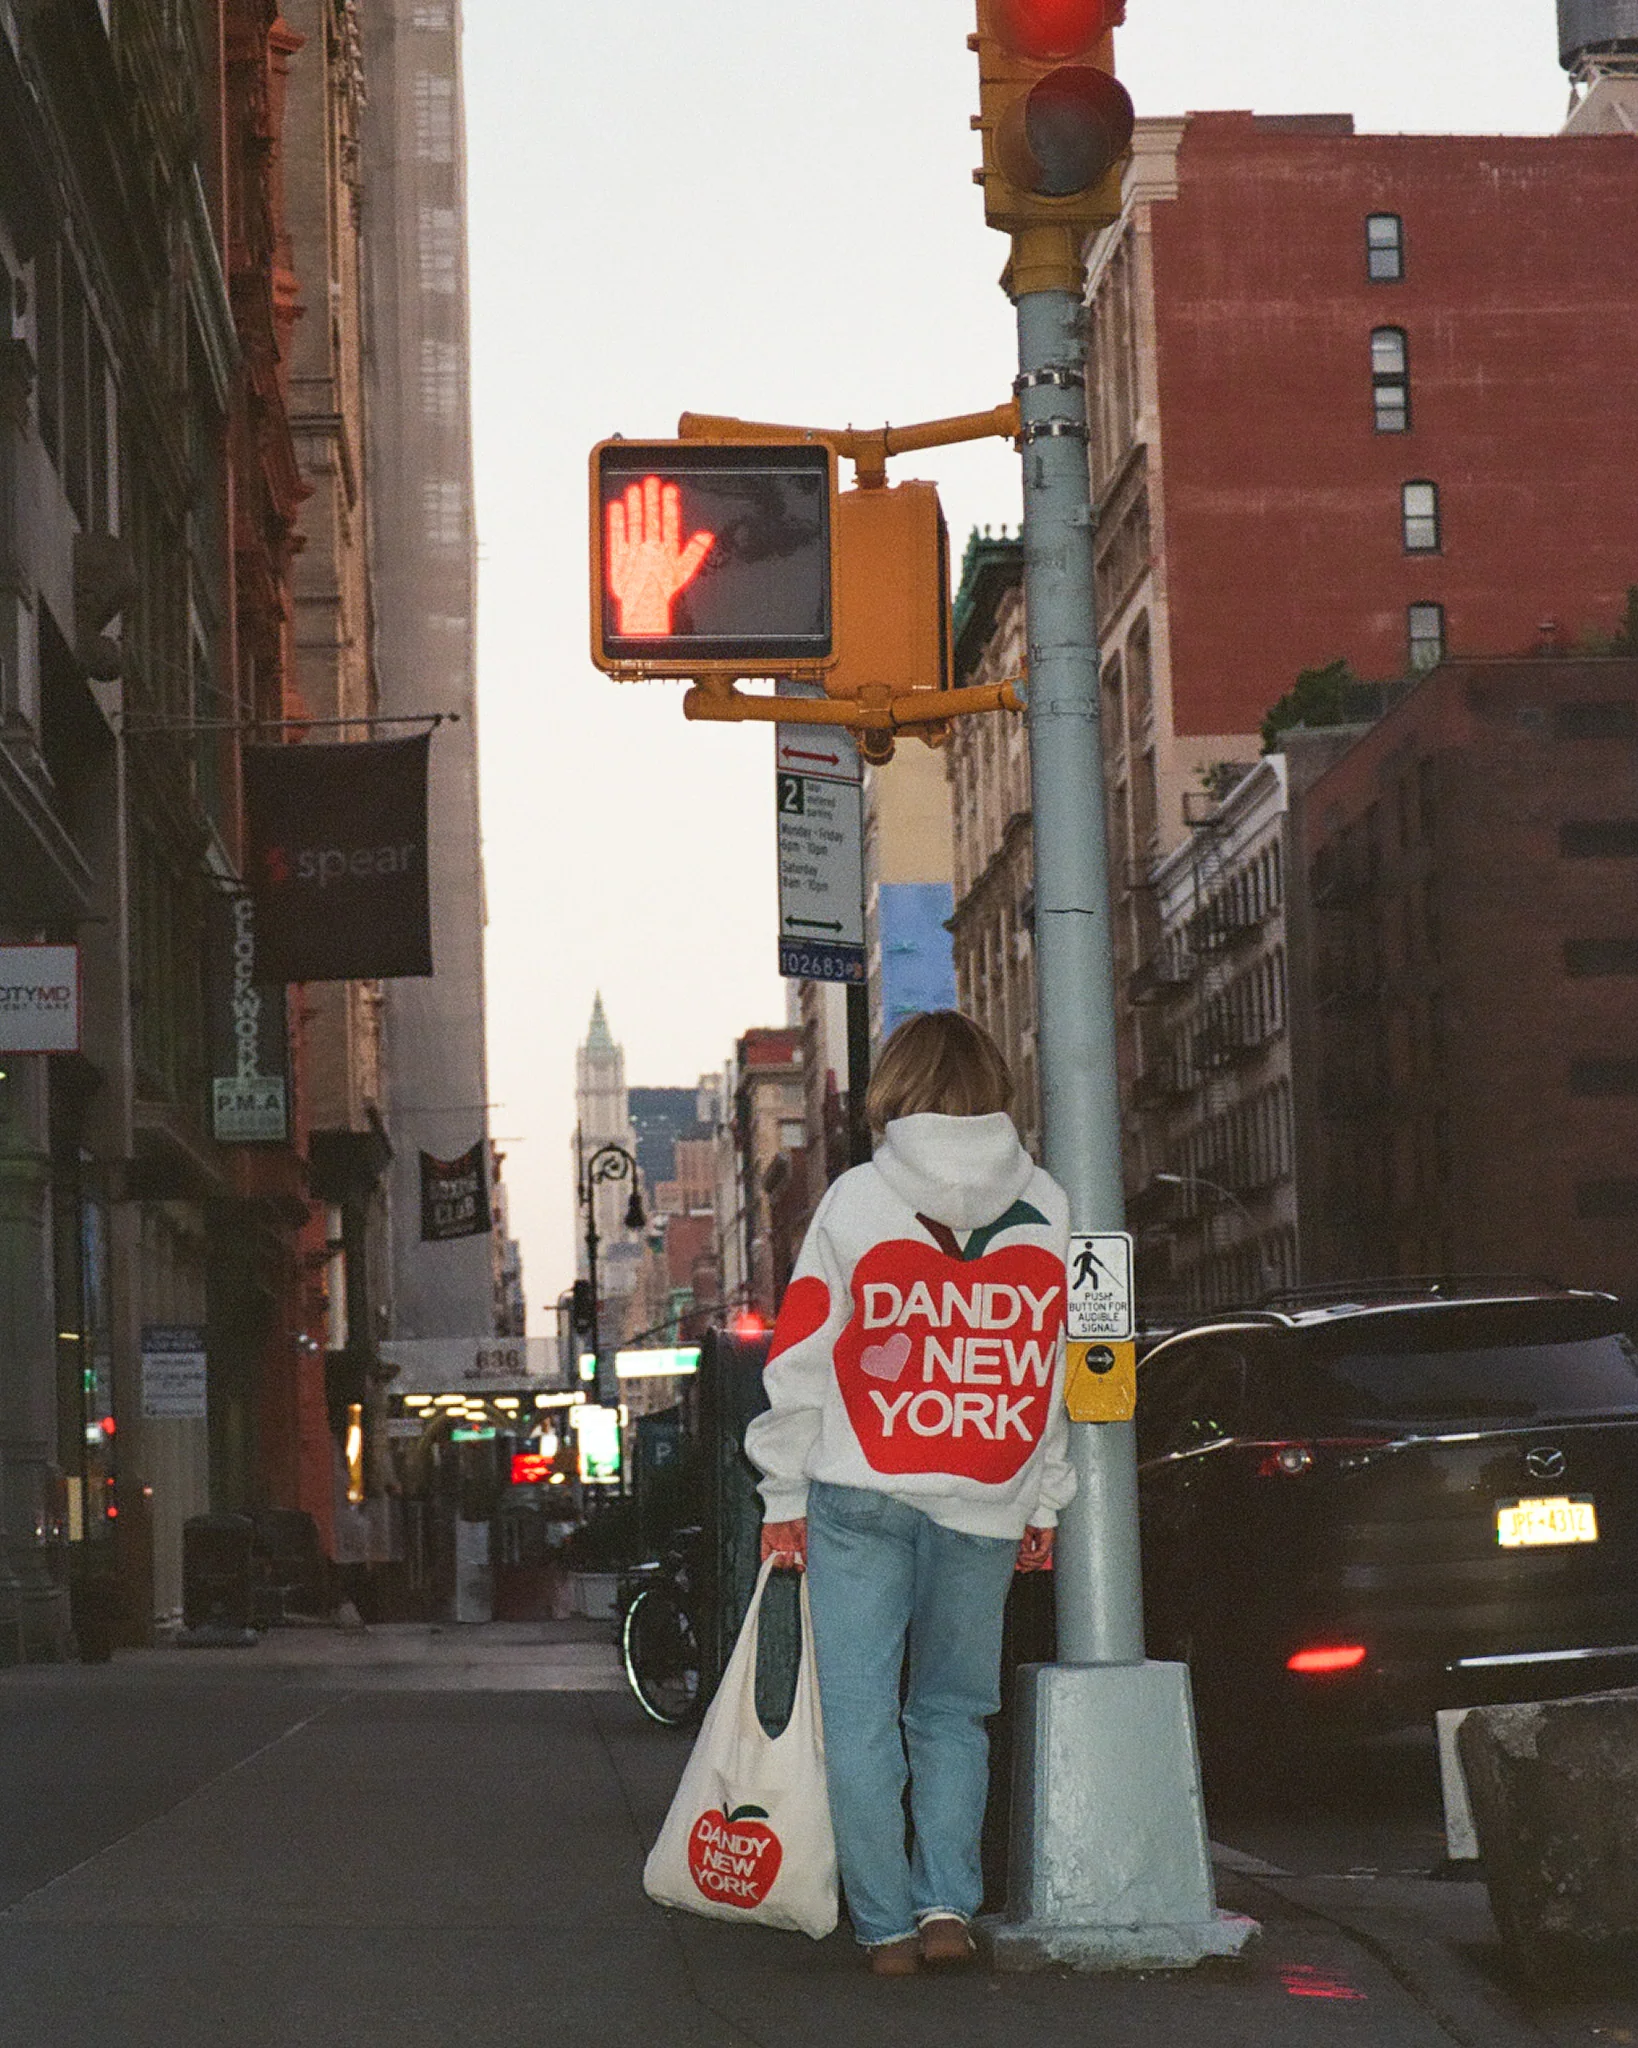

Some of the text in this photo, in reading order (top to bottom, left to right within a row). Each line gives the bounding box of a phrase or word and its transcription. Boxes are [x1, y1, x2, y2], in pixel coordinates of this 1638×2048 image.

[784, 779, 799, 811] 2
[781, 823, 843, 845] Monday Friday
[299, 845, 417, 887] spear
[782, 860, 818, 877] Saturday
[781, 950, 845, 978] 102683
[231, 898, 262, 1079] CLOCKWORK
[863, 1281, 1060, 1331] DANDY
[1069, 1301, 1127, 1312] BUTTON FOR
[1084, 1292, 1113, 1301] PUSH
[1078, 1312, 1120, 1322] AUDIBLE
[1081, 1323, 1118, 1333] SIGNAL
[923, 1336, 1056, 1387] NEW
[868, 1390, 1035, 1441] YORK
[697, 1819, 771, 1857] DANDY
[702, 1846, 756, 1877] NEW
[694, 1864, 759, 1900] YORK
